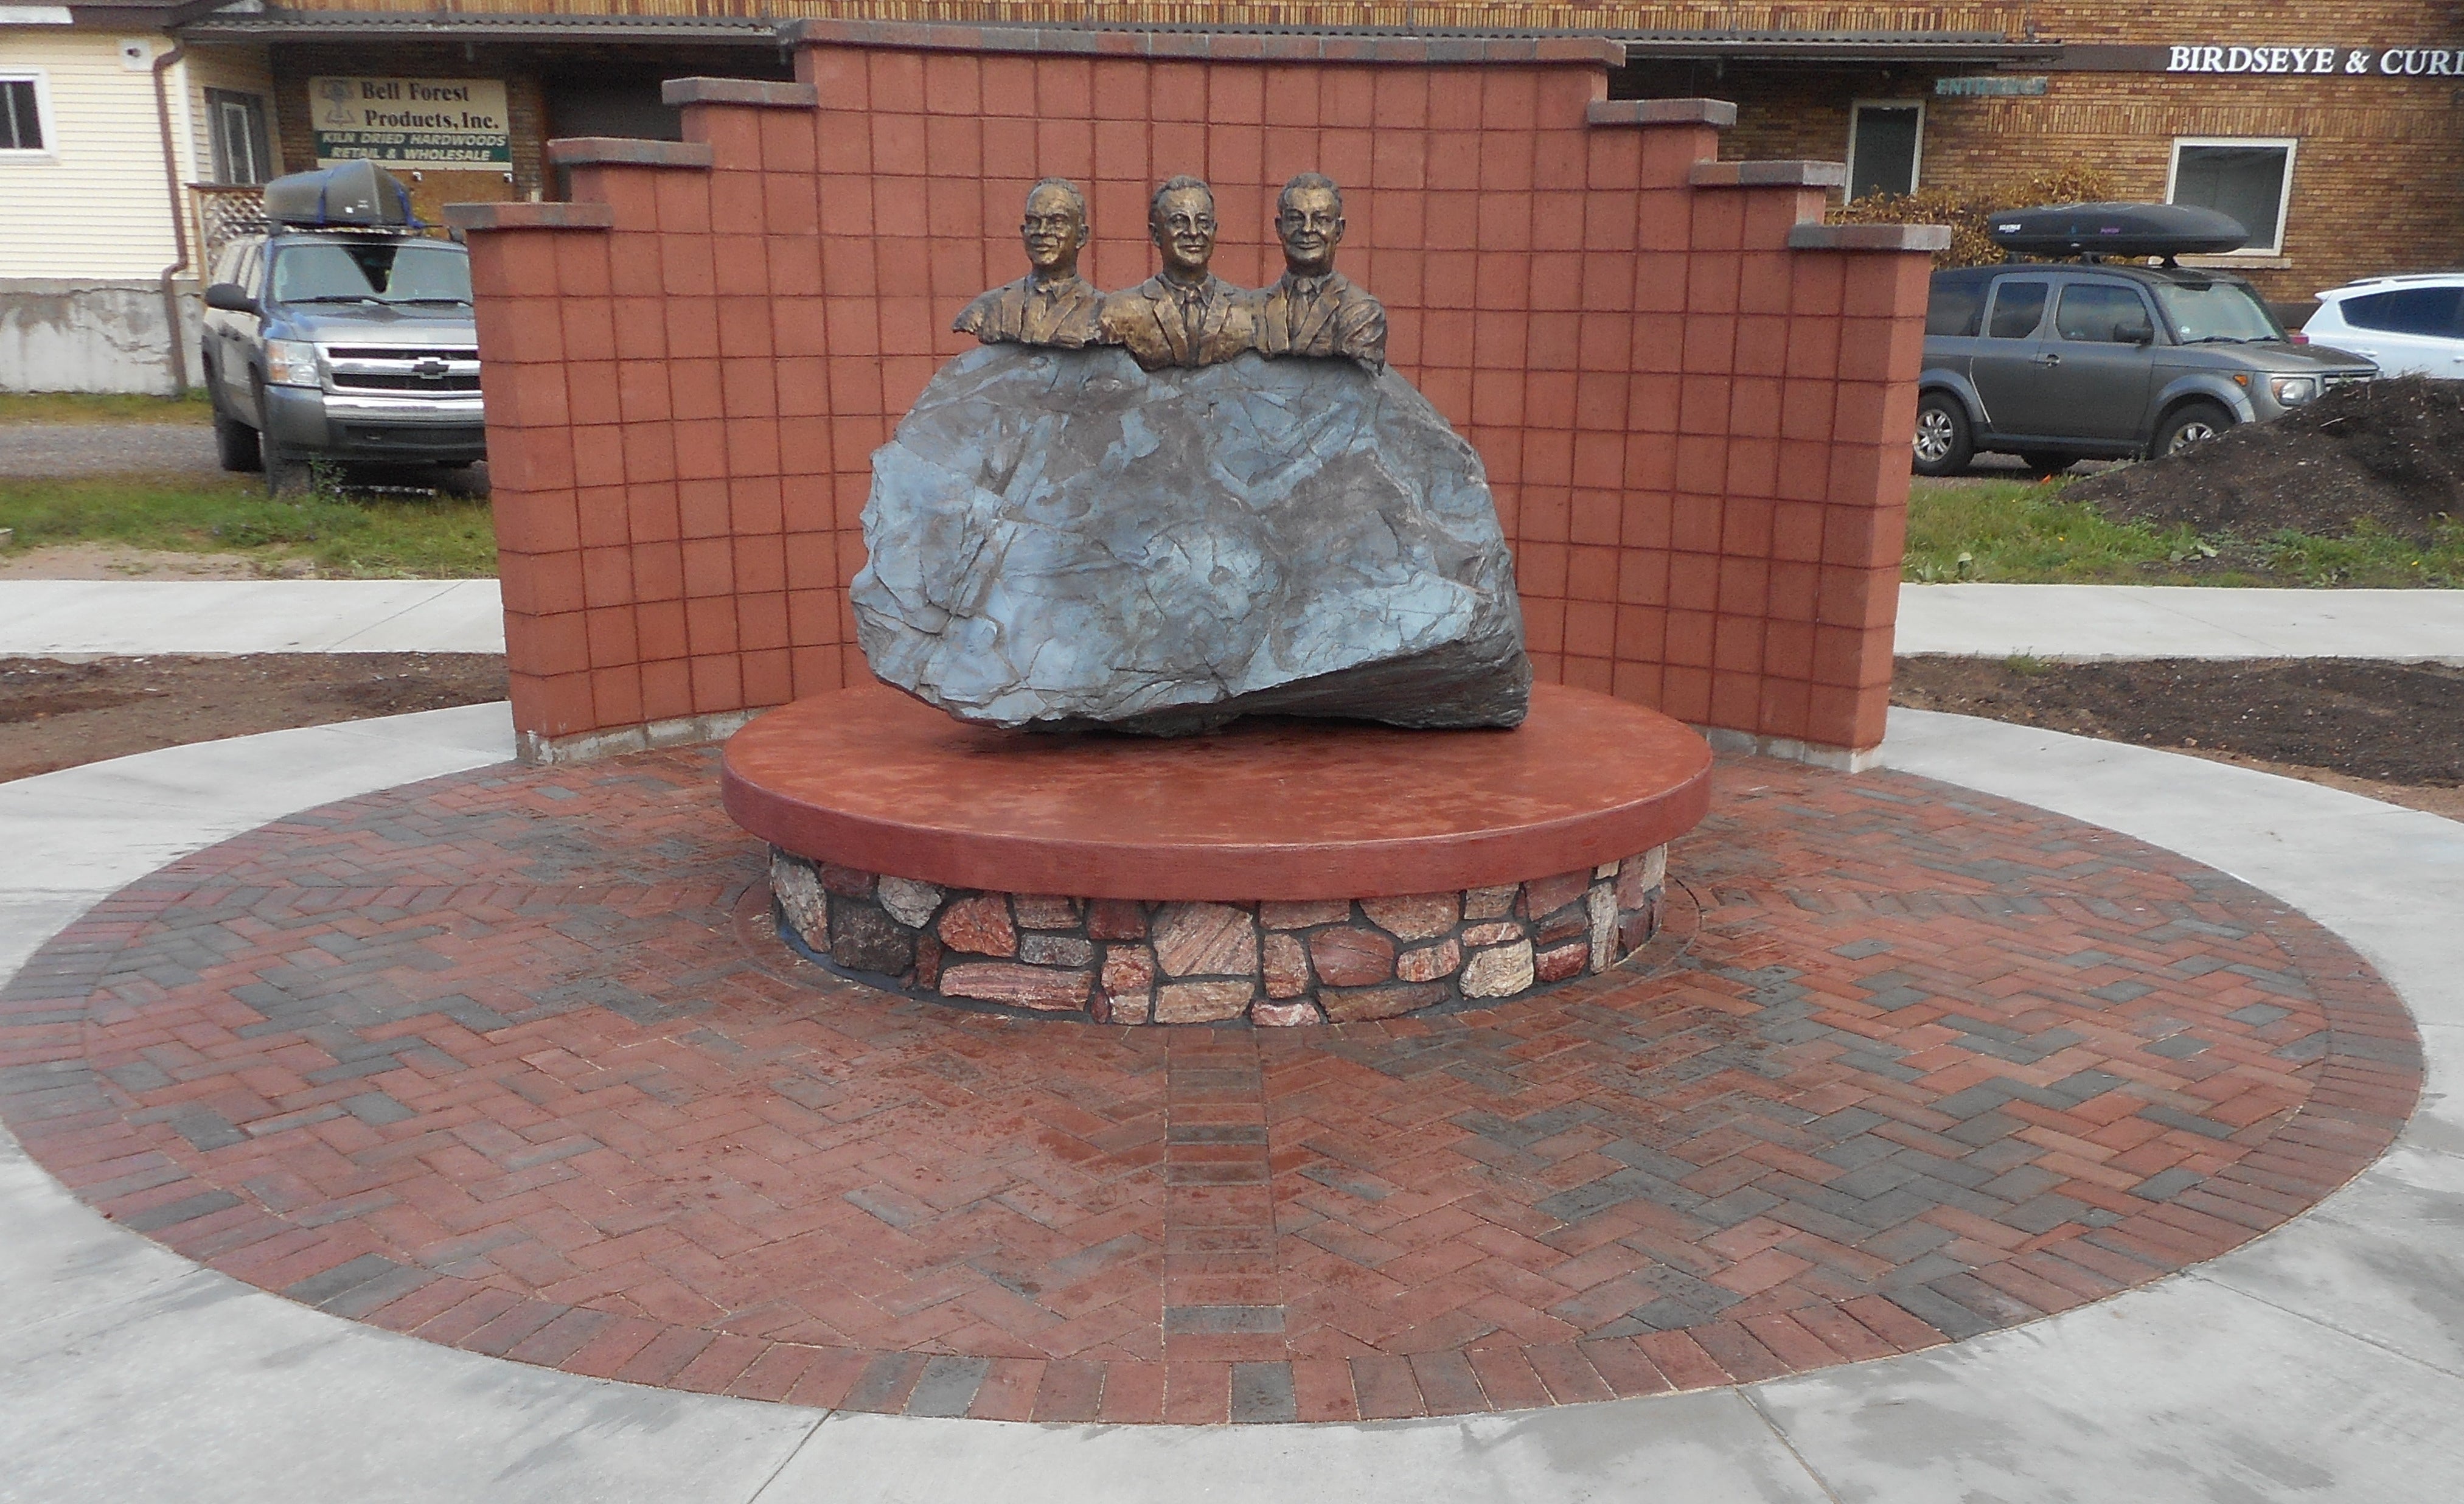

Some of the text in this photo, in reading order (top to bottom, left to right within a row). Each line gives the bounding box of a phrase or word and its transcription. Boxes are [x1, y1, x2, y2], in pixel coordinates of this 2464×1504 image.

[2166, 46, 2335, 73] BIRDSEYE
[2345, 50, 2370, 74] &
[361, 82, 470, 102] Bell Forest
[1936, 77, 2048, 95] ENTRANCE
[365, 110, 499, 130] Products, Inc.
[322, 132, 506, 147] KILN DRIED HARDWOODS
[330, 147, 490, 161] RETAIL & WHOLESALE
